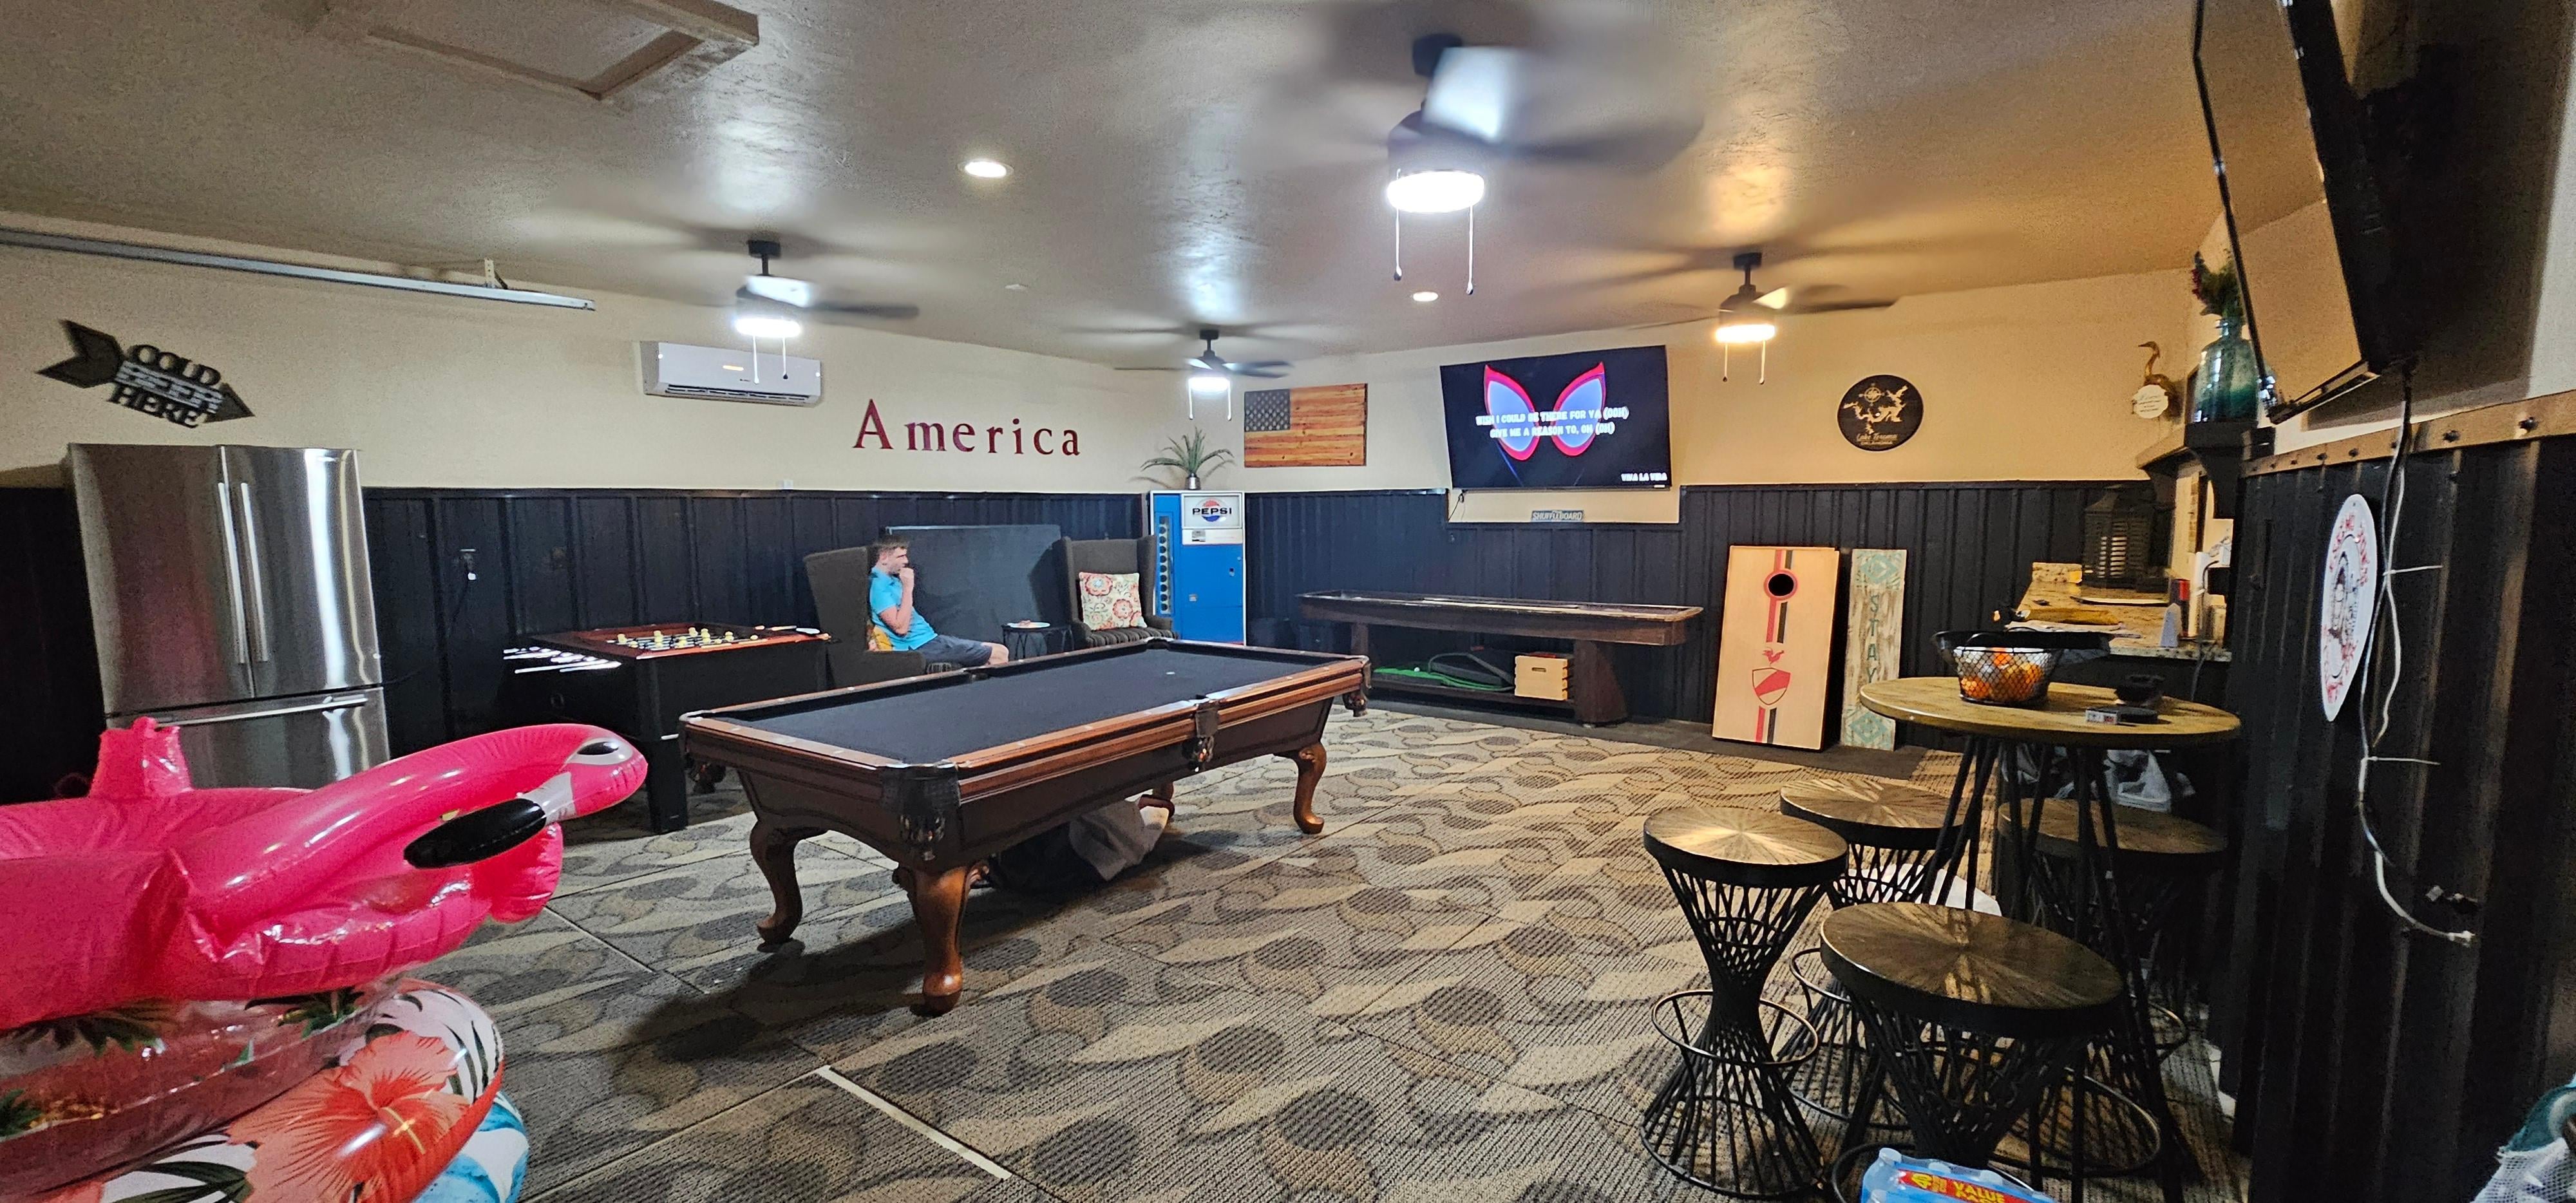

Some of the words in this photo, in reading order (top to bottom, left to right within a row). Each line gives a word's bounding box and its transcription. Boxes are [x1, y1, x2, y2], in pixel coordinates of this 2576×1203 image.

[115, 360, 223, 413] BEER
[128, 345, 221, 386] COLD
[106, 383, 199, 428] HERE
[1475, 415, 1494, 426] WISH
[1496, 415, 1499, 423] I
[1501, 413, 1526, 423] COULD
[1528, 412, 1539, 422] BE
[1540, 410, 1567, 422] THERE
[1569, 410, 1586, 419] FOR
[1588, 410, 1602, 419] YA
[853, 399, 1081, 456] America
[1490, 428, 1508, 438] GIVE
[1509, 428, 1521, 437] ME
[1523, 427, 1530, 436] A
[1531, 426, 1564, 436] REASON
[1566, 425, 1579, 435] TO,
[1581, 424, 1593, 434] OH
[1867, 594, 1880, 683] STAY
[1953, 1180, 2005, 1202] VALUE
